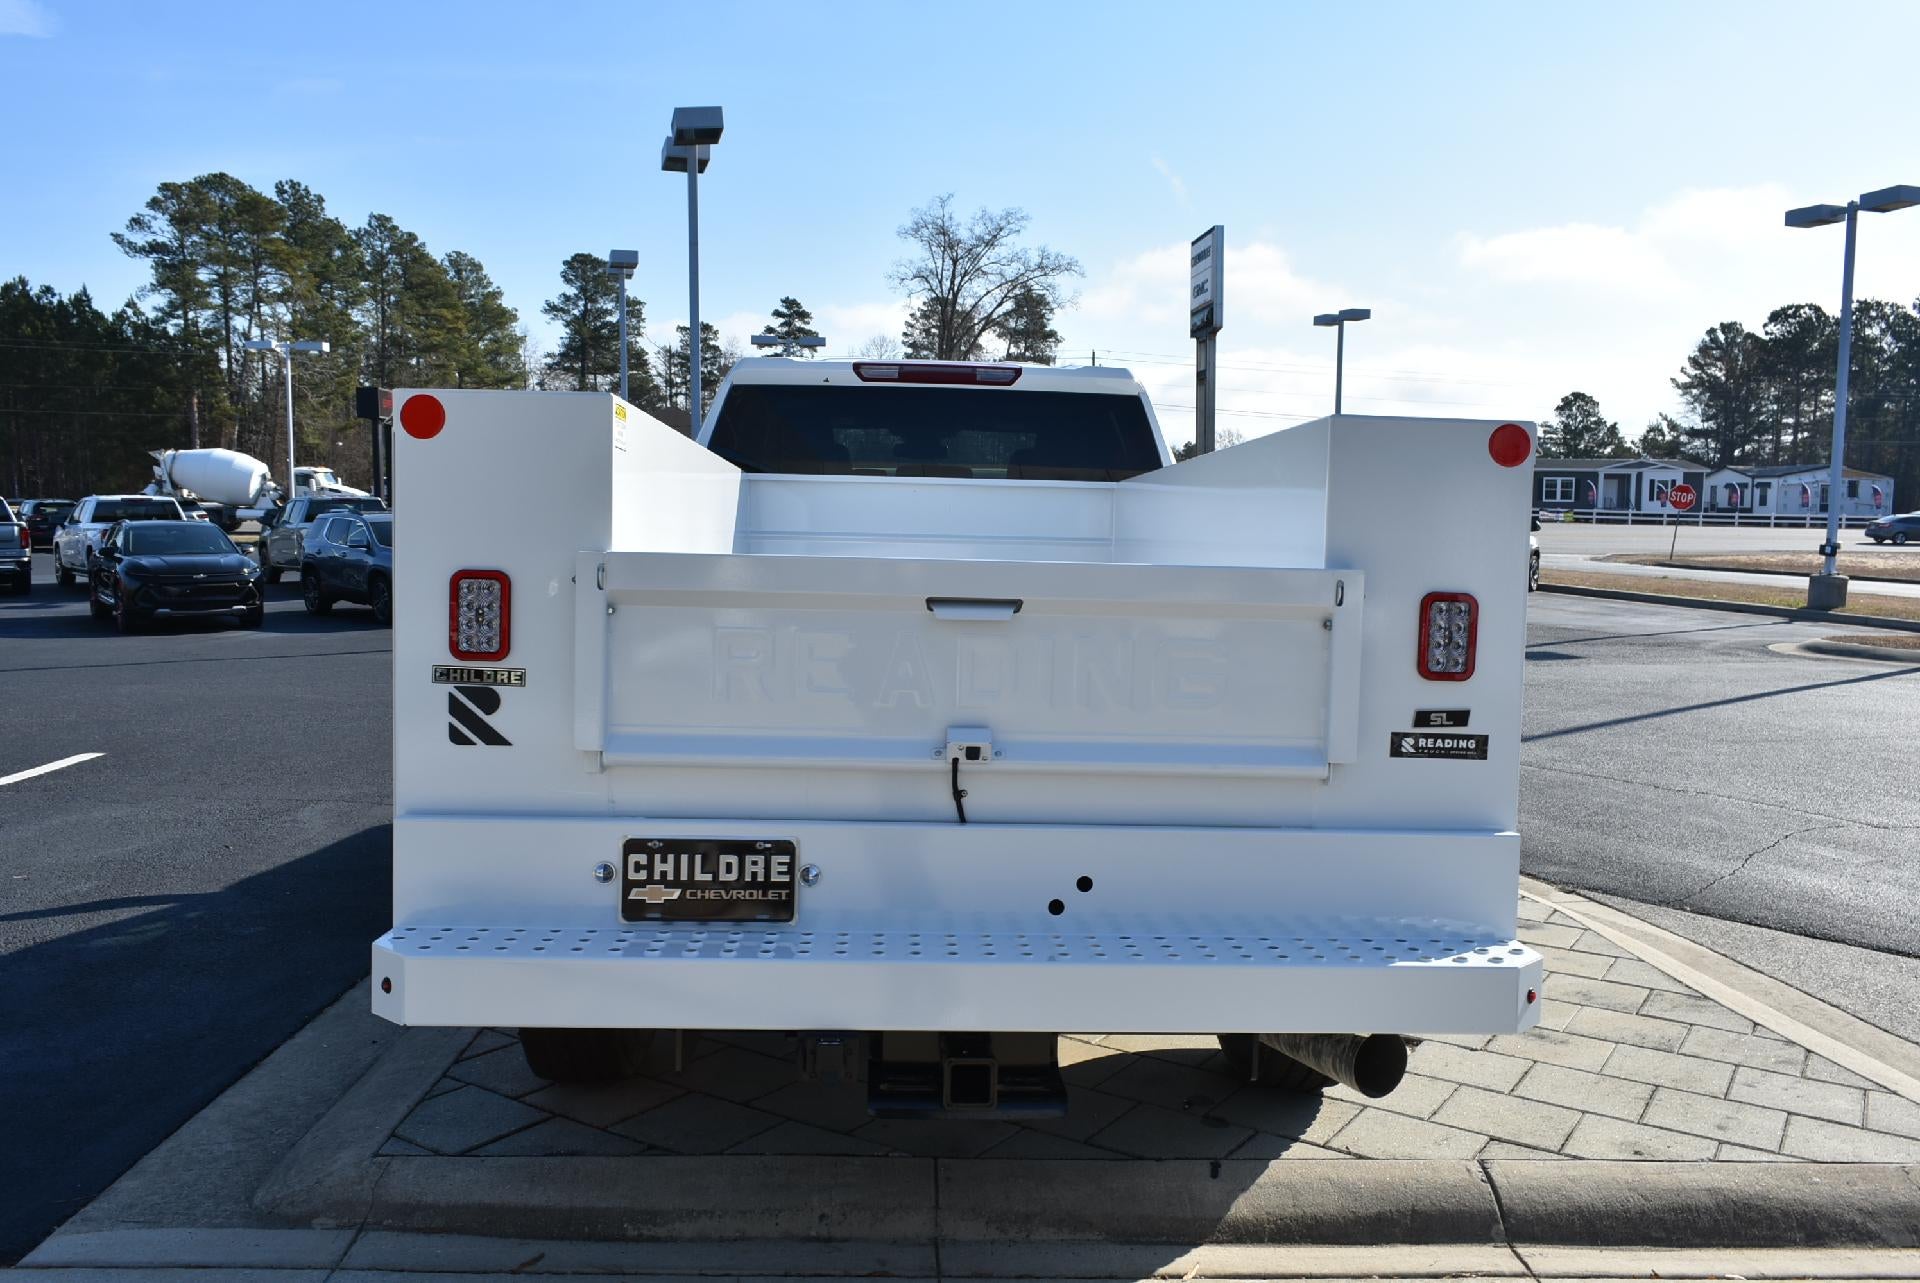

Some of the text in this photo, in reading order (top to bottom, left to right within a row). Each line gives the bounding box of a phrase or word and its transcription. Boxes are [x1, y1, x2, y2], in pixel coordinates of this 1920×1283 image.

[1193, 278, 1208, 298] GMC
[1670, 491, 1694, 503] STOP
[709, 625, 1231, 711] READING
[435, 668, 523, 684] CHILDRE
[1429, 712, 1454, 725] SL
[1418, 738, 1476, 749] READING
[627, 853, 791, 882] CHILDRE
[685, 889, 790, 901] CHEVROLET
